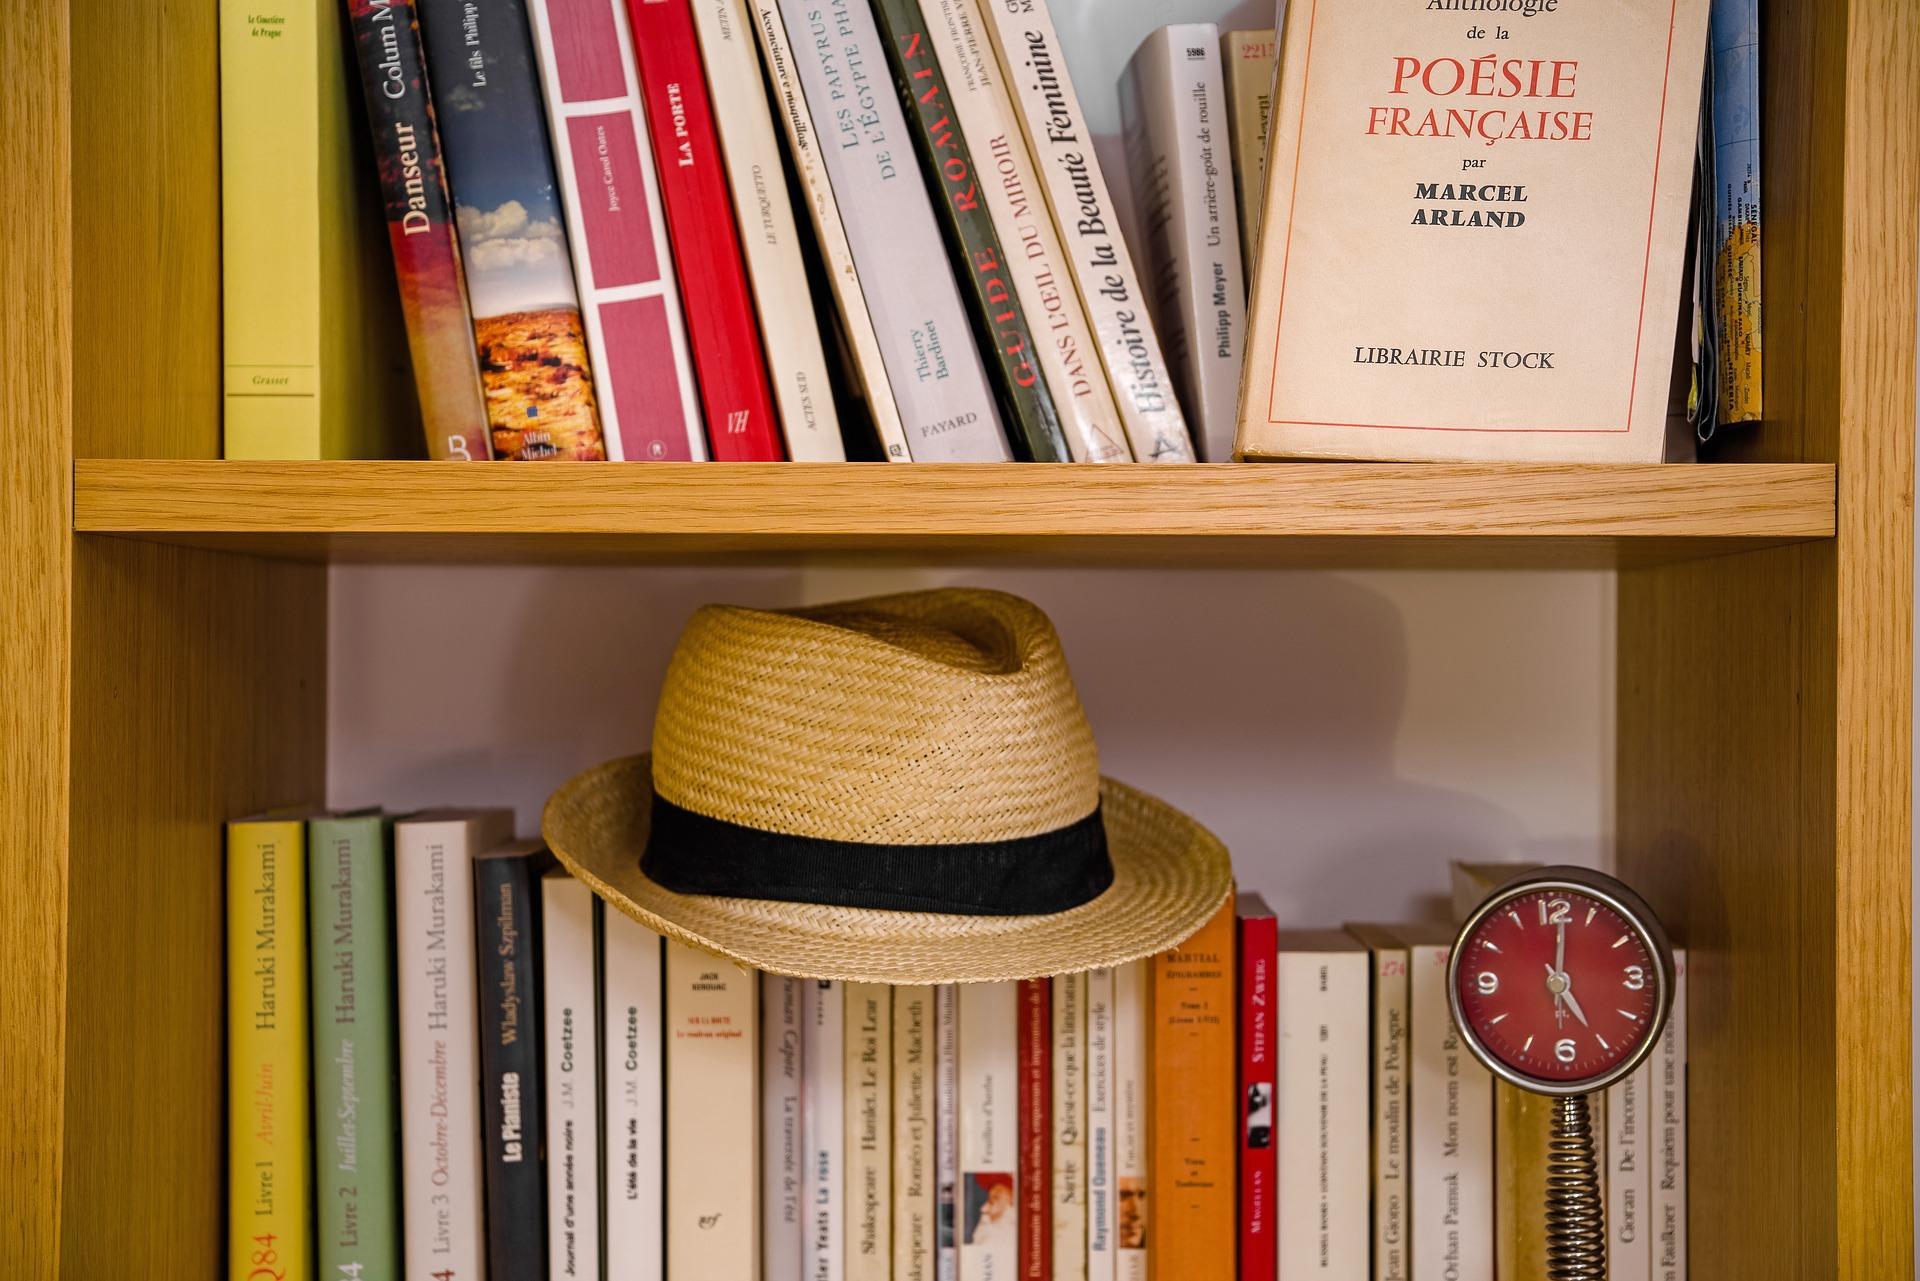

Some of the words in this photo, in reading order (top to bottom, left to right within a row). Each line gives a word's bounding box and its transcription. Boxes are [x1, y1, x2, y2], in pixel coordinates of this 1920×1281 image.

[248, 15, 255, 24] Le
[462, 3, 480, 46] Philipp
[1426, 0, 1559, 17] Anthologie
[252, 27, 259, 36] de
[261, 27, 282, 39] Prague
[1466, 26, 1485, 39] de
[1495, 26, 1510, 40] la
[379, 26, 406, 100] Colum
[469, 50, 483, 70] fils
[808, 9, 845, 100] PAPYRUS
[472, 71, 487, 87] Le
[845, 44, 885, 143] L'ÉGYPTE
[1024, 30, 1078, 145] Féminine
[1388, 53, 1579, 98] POÉSIE
[667, 83, 688, 138] PORTE
[1192, 82, 1209, 123] rouille
[837, 108, 859, 150] LES
[901, 31, 979, 212] ROMAIN
[1197, 128, 1210, 142] de
[1364, 106, 1594, 146] FRANÇAISE
[596, 126, 608, 154] Oates
[395, 122, 430, 236] Danseur
[600, 157, 614, 184] Carol
[877, 151, 896, 181] DE
[989, 133, 1032, 219] MIROIR
[1461, 158, 1486, 171] par
[607, 185, 620, 212] Joyce
[752, 165, 773, 229] TURQUETTO
[1058, 152, 1108, 237] Beauté
[1199, 148, 1219, 222] arrière-goût
[1414, 183, 1528, 202] MARCEL
[1410, 208, 1526, 229] ARLAND
[766, 232, 777, 244] LE
[1018, 224, 1045, 260] DU
[1207, 227, 1221, 247] Un
[1090, 243, 1117, 268] la
[1034, 263, 1070, 331] L'ŒIL
[1099, 275, 1129, 302] de
[1212, 262, 1227, 306] Meyer
[974, 247, 1037, 388] GUIDE
[1216, 310, 1232, 358] Philipp
[910, 329, 932, 382] Thierry
[924, 319, 949, 380] Bardinet
[1056, 335, 1092, 398] DANS
[1116, 310, 1166, 413] Histoire
[1353, 346, 1466, 367] LIBRAIRIE
[1477, 350, 1555, 369] STOCK
[252, 374, 289, 386] Grasset
[796, 371, 808, 393] SUD
[801, 396, 818, 432] ACTES
[921, 412, 977, 437] FAYARD
[254, 843, 276, 950] Murakami
[331, 838, 354, 945] Murakami
[424, 843, 446, 951] Murakami
[497, 882, 518, 957] Szpilman
[1538, 898, 1573, 926] 12
[1167, 953, 1217, 963] MARTIAL
[254, 956, 276, 1031] Haruki
[332, 951, 355, 1024] Haruki
[426, 956, 448, 1031] Haruki
[1252, 958, 1266, 1007] ZWEIG
[1478, 971, 1498, 995] 9
[1623, 965, 1644, 990] 3
[783, 976, 794, 1024] ruman
[862, 999, 877, 1032] Lear
[1092, 1003, 1107, 1032] style
[560, 1008, 573, 1072] Coetzee
[624, 1006, 638, 1071] Coetzee
[861, 1037, 877, 1063] Roi
[907, 1001, 923, 1063] Macbeth
[1062, 1037, 1075, 1048] la
[1092, 1037, 1105, 1051] de
[1250, 1012, 1265, 1063] STEFAN
[1384, 1008, 1405, 1070] Pologne
[778, 1030, 798, 1078] Capote
[1445, 1056, 1458, 1076] est
[1555, 1039, 1576, 1062] 6
[862, 1068, 877, 1088] Le
[1385, 1077, 1399, 1095] de
[1664, 1059, 1675, 1086] une
[334, 1039, 361, 1174] Juillet-Septembre
[428, 1040, 449, 1187] Octobre-Décembre
[500, 1072, 521, 1141] Pianiste
[784, 1096, 797, 1112] La
[1446, 1081, 1458, 1116] nom
[1663, 1090, 1680, 1124] pour
[562, 1120, 573, 1150] noire
[625, 1119, 637, 1135] vie
[626, 1139, 637, 1149] la
[910, 1127, 922, 1140] et
[1384, 1101, 1400, 1154] moulin
[1443, 1121, 1459, 1157] Mon
[501, 1142, 522, 1162] Le
[626, 1153, 637, 1168] de
[817, 1150, 829, 1182] rose
[1092, 1127, 1106, 1187] Queneau
[1384, 1159, 1399, 1180] Le
[1619, 1150, 1635, 1172] De
[1659, 1127, 1680, 1190] Requiem
[563, 1155, 574, 1191] année
[626, 1171, 638, 1200] L'été
[784, 1177, 797, 1192] de
[254, 1173, 274, 1216] Livre
[338, 1186, 358, 1198] 2
[431, 1195, 449, 1205] 3
[815, 1188, 829, 1205] La
[1442, 1172, 1459, 1225] Pamuk
[339, 1203, 359, 1248] Livre
[563, 1195, 574, 1228] d'une
[861, 1167, 879, 1255] Shakespeare
[1092, 1189, 1108, 1251] Raymond
[1384, 1195, 1400, 1244] Giono
[1619, 1189, 1635, 1244] Cioran
[432, 1210, 452, 1254] Livre
[815, 1211, 829, 1250] Yeats
[1659, 1205, 1676, 1267] Faulkner
[563, 1232, 575, 1276] Journal
[1442, 1231, 1459, 1281] Orhan
